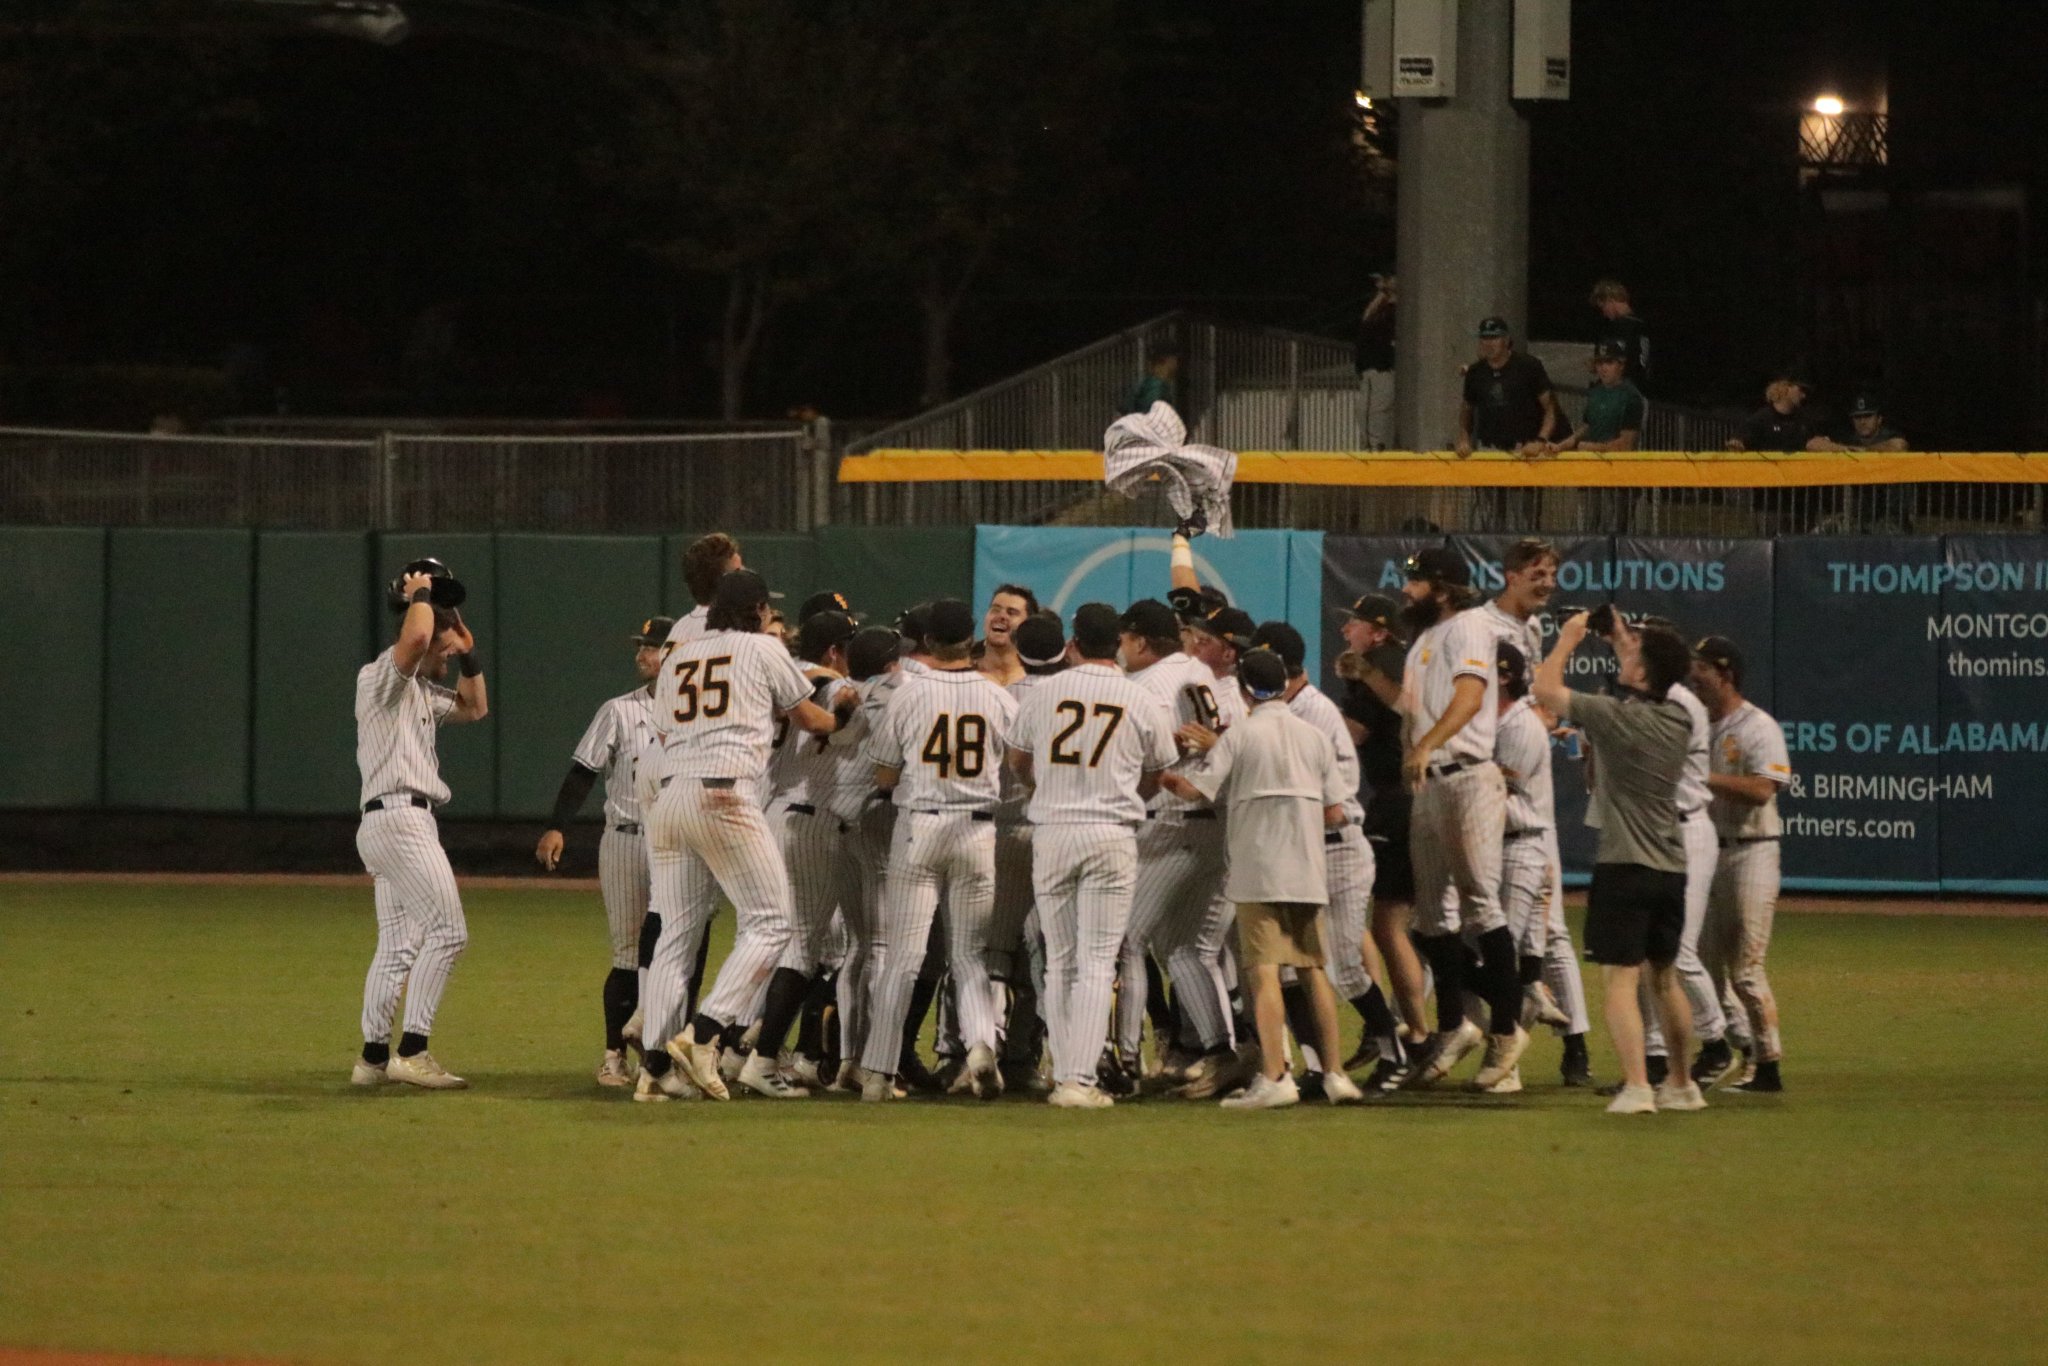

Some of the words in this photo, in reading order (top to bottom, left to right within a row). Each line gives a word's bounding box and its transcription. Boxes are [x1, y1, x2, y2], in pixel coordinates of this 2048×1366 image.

[1557, 561, 1726, 592] OLUTIONS
[1827, 560, 2026, 594] THOMPSON
[673, 655, 733, 724] 35
[921, 713, 987, 779] 48
[1050, 699, 1125, 768] 27
[1846, 723, 1893, 753] OF
[1789, 774, 1808, 799] &
[1814, 774, 1993, 802] BIRMINGHAM
